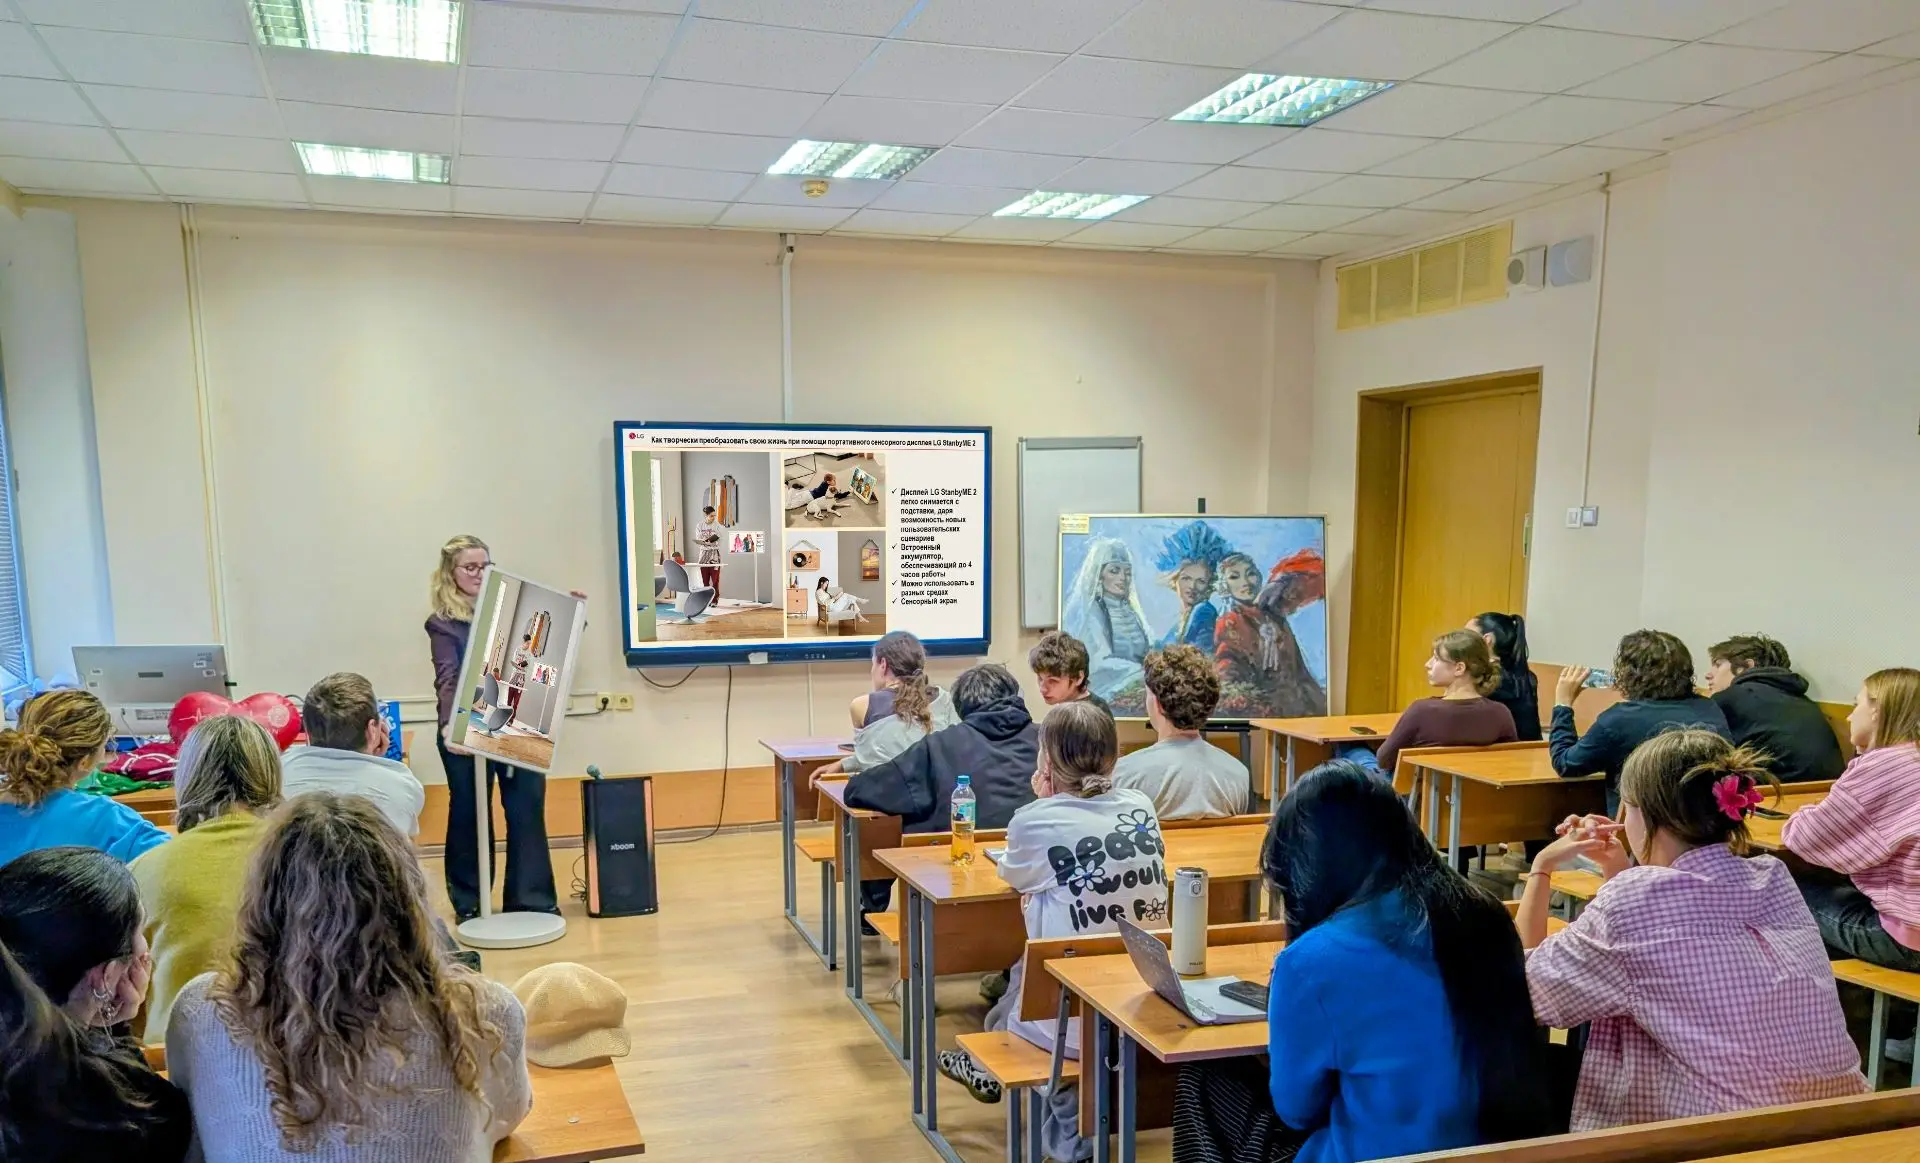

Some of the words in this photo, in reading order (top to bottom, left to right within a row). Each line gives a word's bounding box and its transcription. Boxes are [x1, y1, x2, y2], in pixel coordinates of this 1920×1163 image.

[651, 435, 663, 444] Как
[664, 437, 699, 445] творчески
[699, 436, 749, 446] преобразовать
[788, 438, 800, 446] при
[801, 438, 827, 446] помощи
[827, 439, 870, 447] портативного
[871, 439, 907, 447] сенсорного
[907, 439, 932, 447] дисплея
[933, 439, 942, 447] LG
[900, 488, 929, 497] Дисплей
[930, 488, 940, 496] LG
[937, 508, 954, 516] даря
[900, 543, 941, 552] Встроенный
[900, 553, 944, 562] аккумулятор,
[900, 561, 957, 570] обеспечивающий
[967, 560, 973, 568] 4
[921, 570, 946, 579] работы
[900, 590, 925, 598] разных
[926, 589, 949, 598] средах
[900, 598, 938, 607] Сенсорный
[939, 598, 958, 606] экран
[1069, 899, 1127, 932] live
